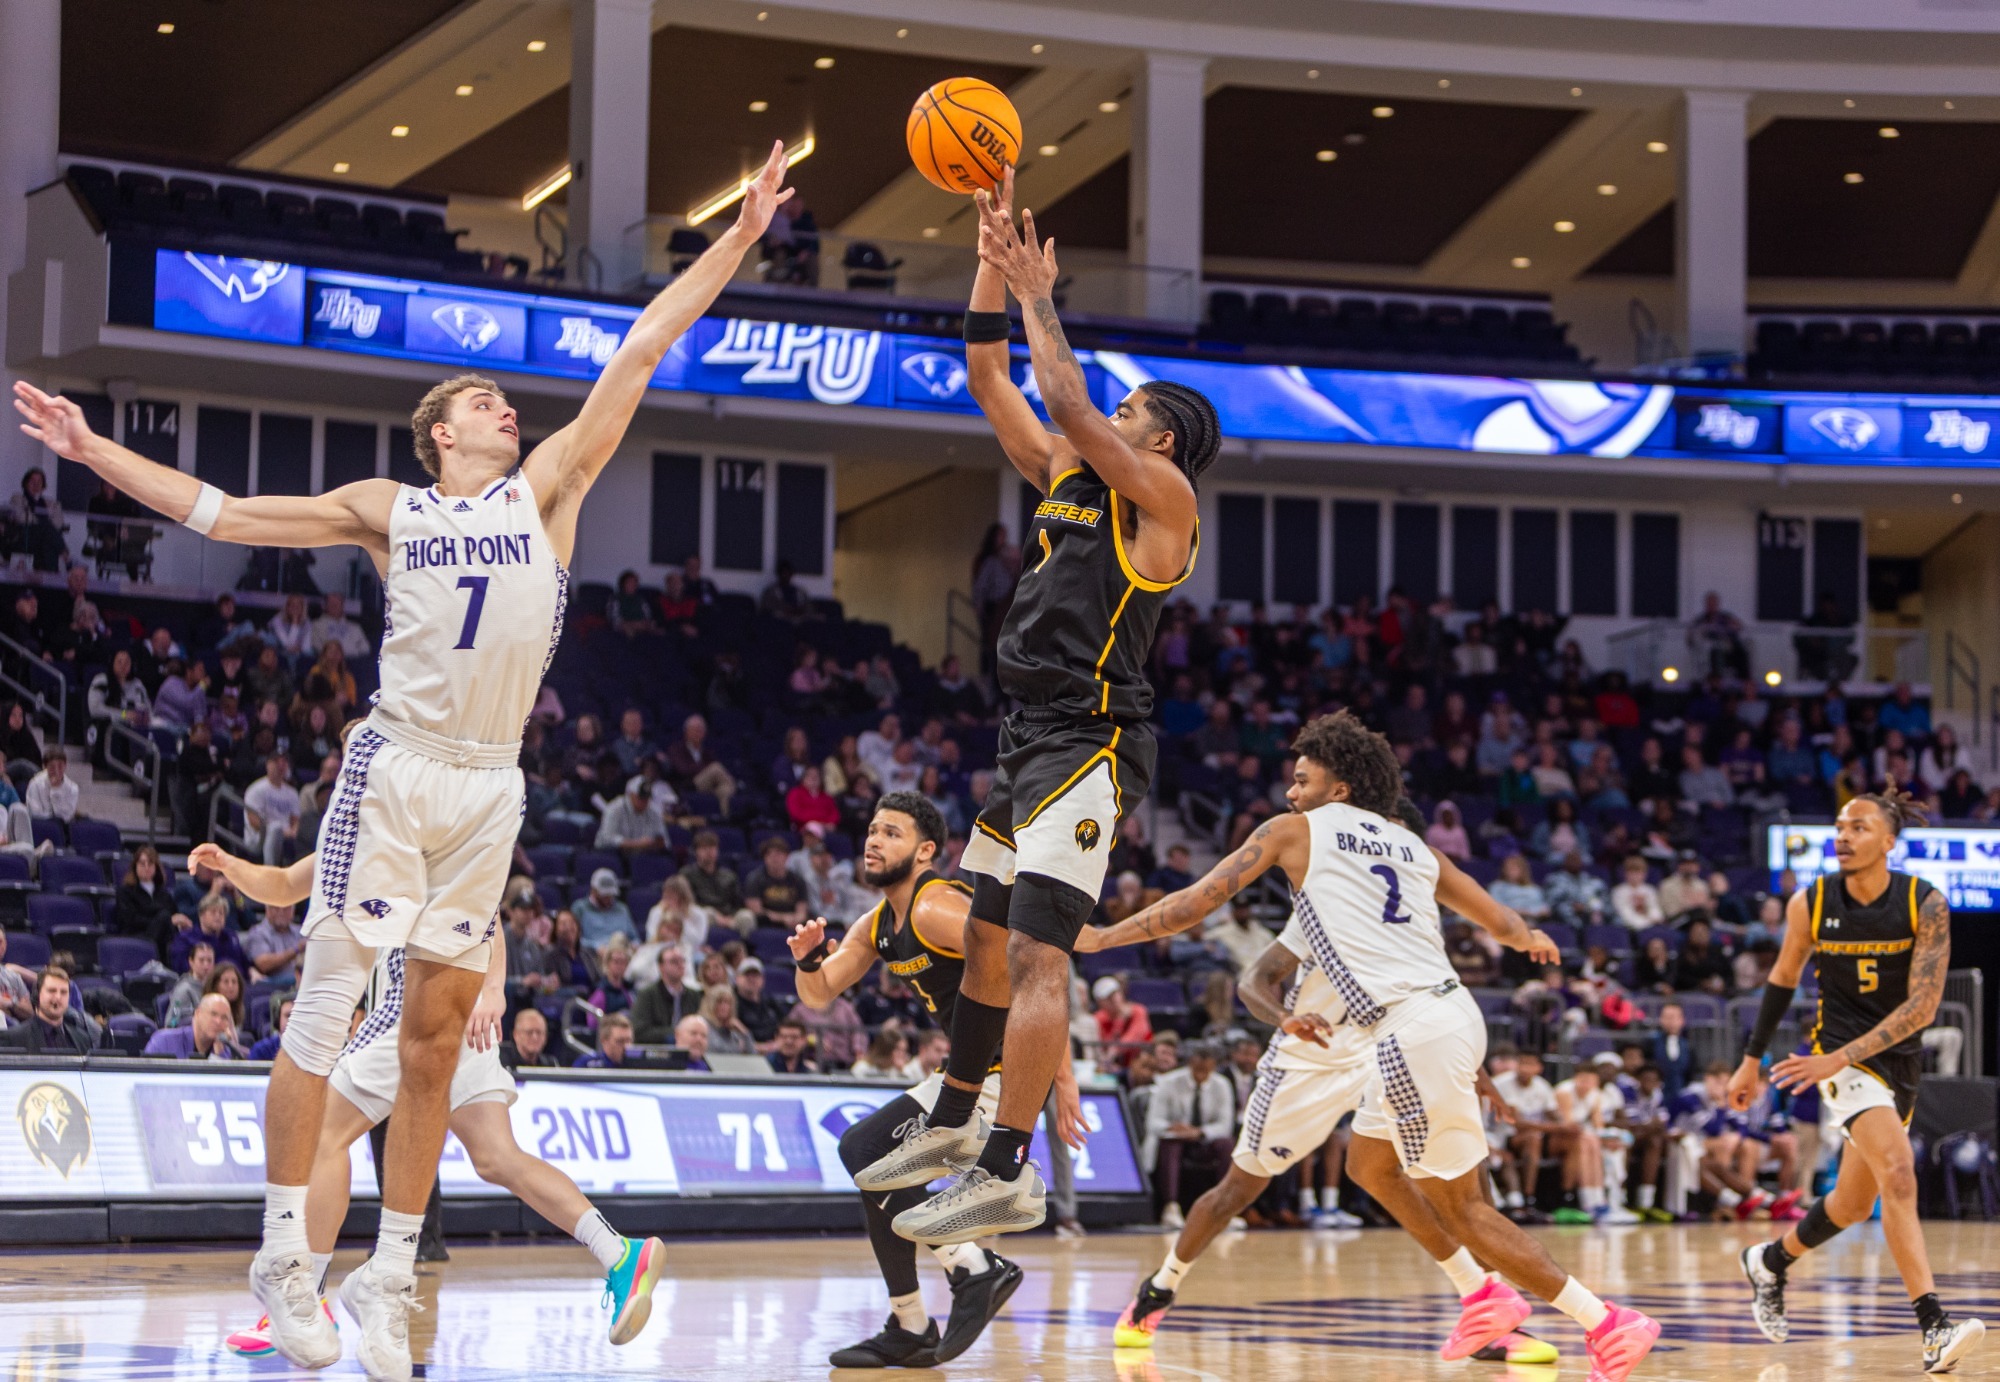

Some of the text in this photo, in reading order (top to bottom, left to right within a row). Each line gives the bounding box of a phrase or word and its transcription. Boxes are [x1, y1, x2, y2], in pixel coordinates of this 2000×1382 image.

[130, 403, 178, 436] 114
[721, 461, 763, 492] 114
[1034, 501, 1101, 526] EIFFER
[405, 533, 531, 571] HIGH POINT
[451, 576, 490, 650] 7
[1336, 832, 1414, 862] BRADY II
[1369, 864, 1412, 924] 2
[1857, 959, 1879, 994] 5
[180, 1100, 266, 1166] 35
[532, 1107, 631, 1160] 2ND
[717, 1113, 788, 1171] 71
